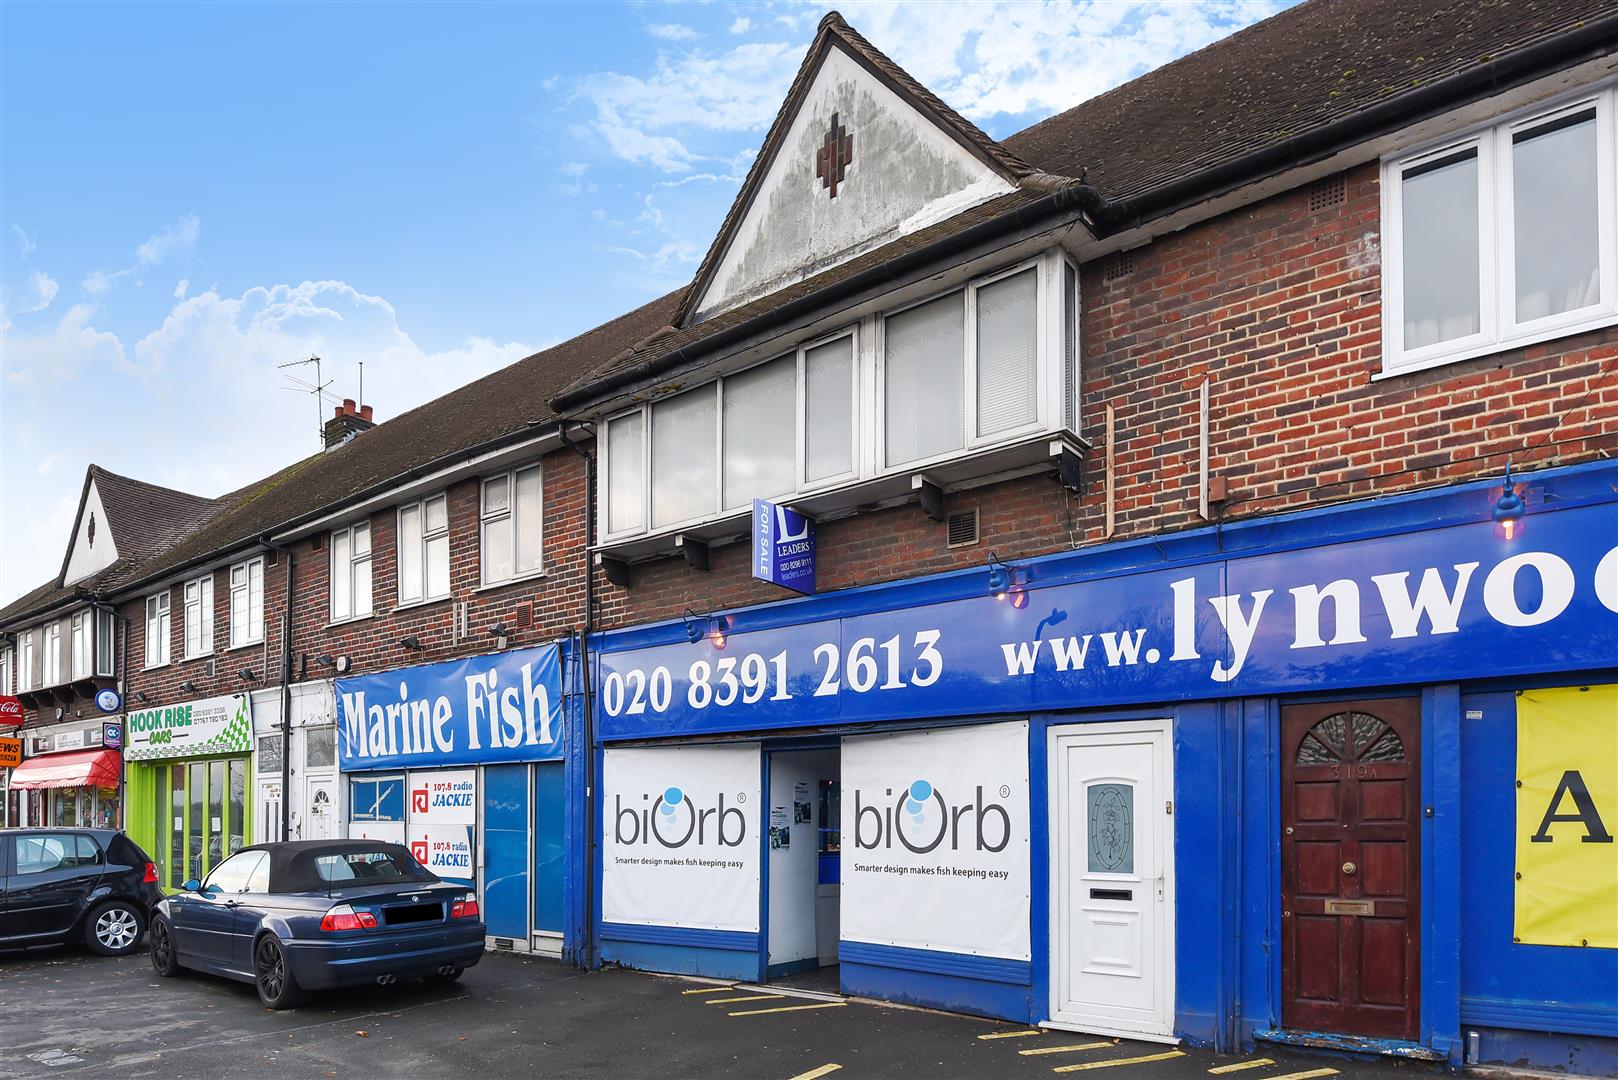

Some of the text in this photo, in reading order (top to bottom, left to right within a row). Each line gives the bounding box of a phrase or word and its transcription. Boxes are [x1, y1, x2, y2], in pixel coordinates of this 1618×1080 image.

[775, 505, 808, 544] L
[760, 504, 769, 576] FOR SALE
[777, 541, 810, 557] LEADERS
[780, 562, 790, 572] 020
[780, 567, 813, 581] leaders.co.uk
[603, 548, 1618, 717] 020 8391 2613 www.lynwo
[130, 704, 193, 733] HOOK RISE
[341, 662, 554, 759] Marine Fish
[149, 729, 173, 745] CARS
[1331, 764, 1377, 779] 319A
[433, 781, 473, 791] 107.8 radio
[432, 793, 473, 807] JACKIE
[1530, 770, 1613, 844] A
[433, 842, 468, 851] 107.8 radio
[432, 853, 469, 867] JACKIE
[640, 857, 663, 867] design
[663, 858, 685, 866] makes
[685, 858, 698, 866] fish
[699, 859, 726, 869] keeping
[727, 861, 744, 869] easy
[854, 863, 1009, 880] Smarter design makes fish keeping easy
